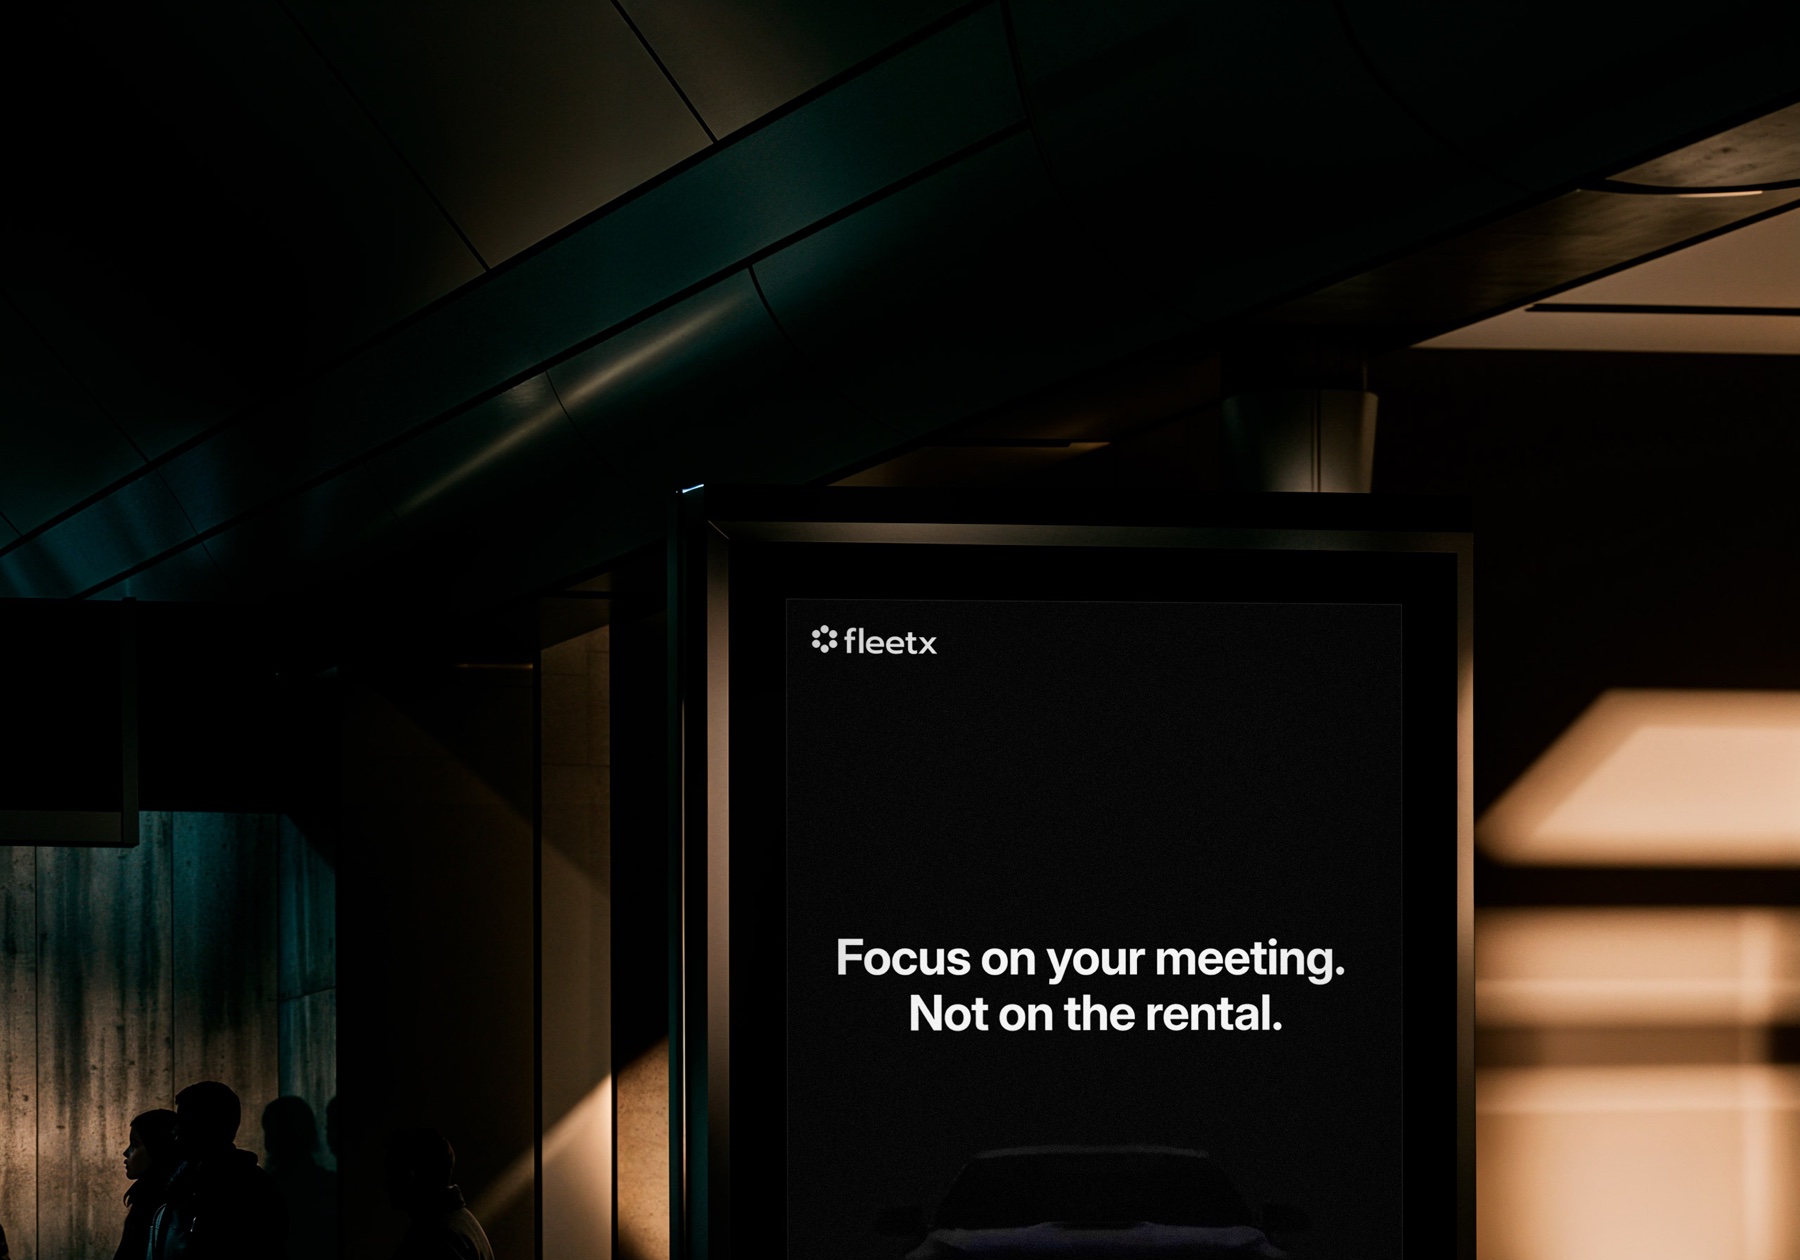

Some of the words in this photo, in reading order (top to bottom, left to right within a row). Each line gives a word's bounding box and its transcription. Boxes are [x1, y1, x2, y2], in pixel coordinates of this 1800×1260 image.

[844, 627, 937, 654] fleetx
[838, 939, 970, 975] Focus
[982, 948, 1035, 975] on
[1046, 948, 1145, 985] your
[1157, 938, 1344, 985] meeting.
[911, 995, 989, 1031] Not
[999, 1004, 1052, 1031] on
[1064, 994, 1135, 1031] the
[1147, 994, 1282, 1031] rental.
